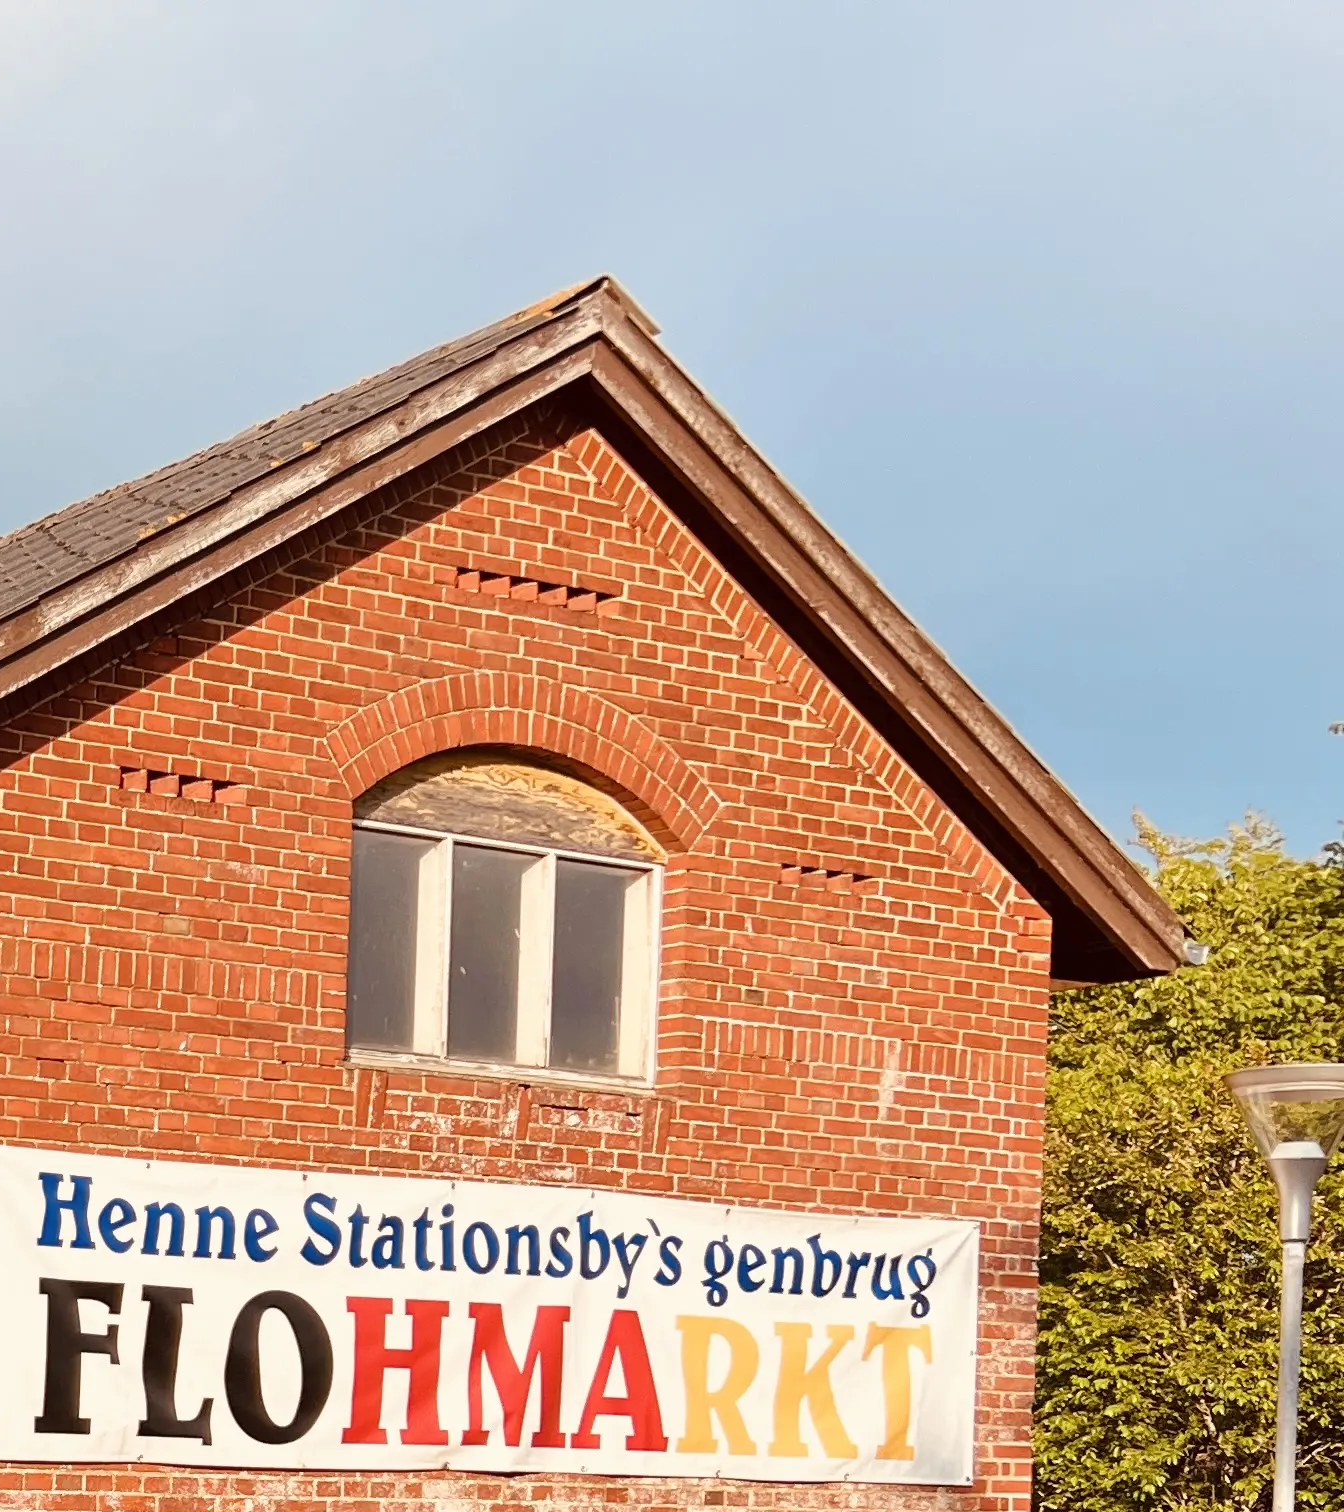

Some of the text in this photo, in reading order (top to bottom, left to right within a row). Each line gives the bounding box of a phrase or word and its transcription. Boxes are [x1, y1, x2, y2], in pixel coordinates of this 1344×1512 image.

[37, 1171, 280, 1262] Henne
[701, 1233, 937, 1318] genbrug
[34, 1277, 933, 1461] FLOHMARKT
